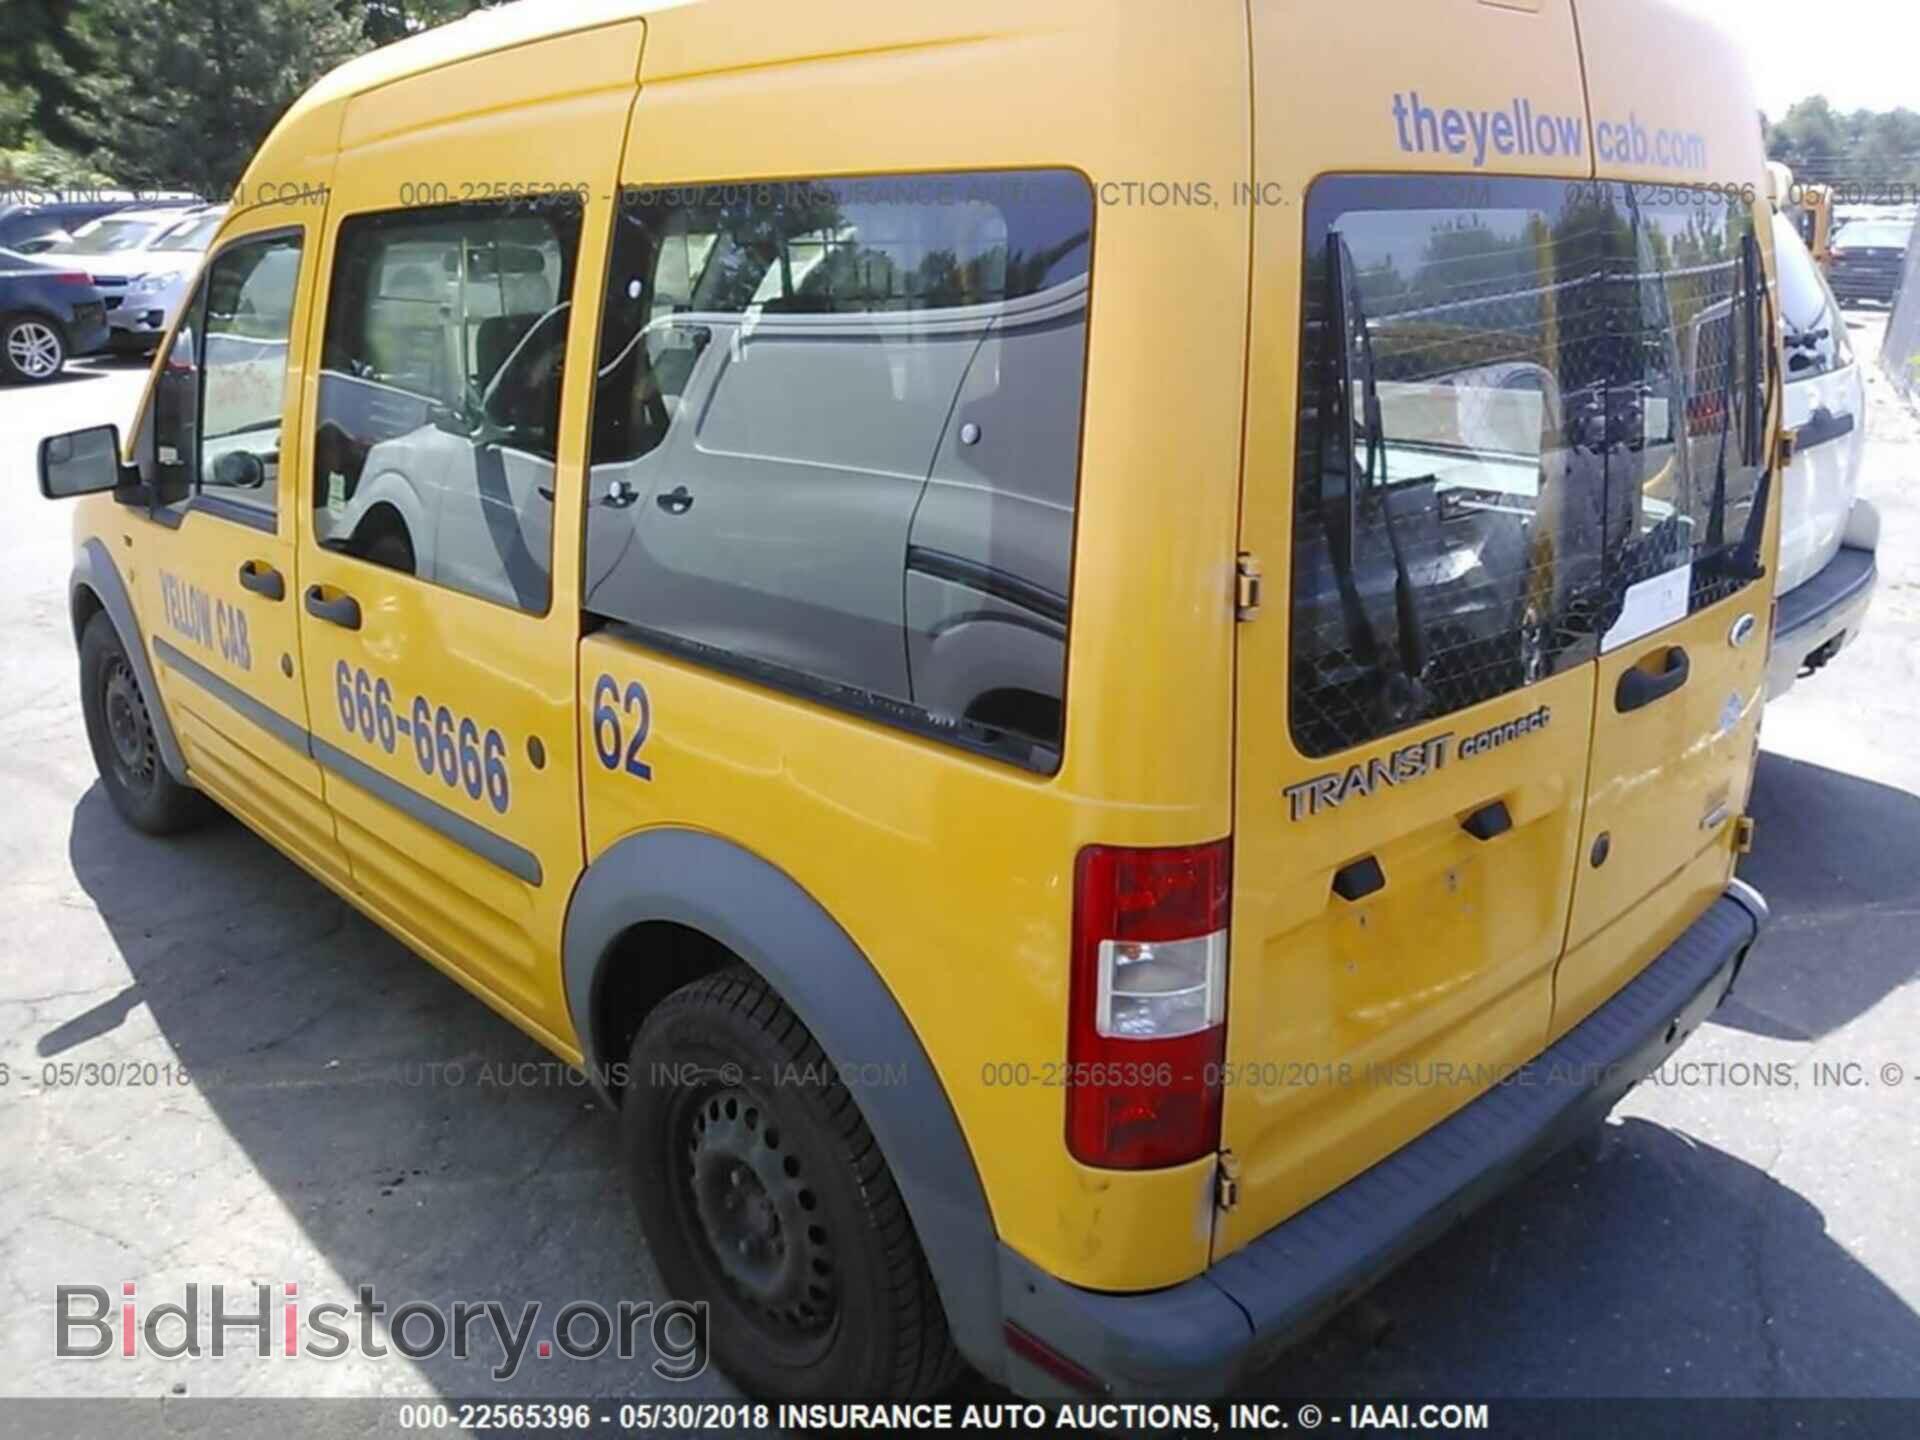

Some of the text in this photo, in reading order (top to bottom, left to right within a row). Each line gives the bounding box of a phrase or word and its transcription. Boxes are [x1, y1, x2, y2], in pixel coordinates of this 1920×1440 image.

[160, 572, 251, 672] YELLOW CAB
[336, 660, 509, 815] 666-6666
[592, 674, 653, 783] 62
[1283, 704, 1551, 823] TRANSIT connect
